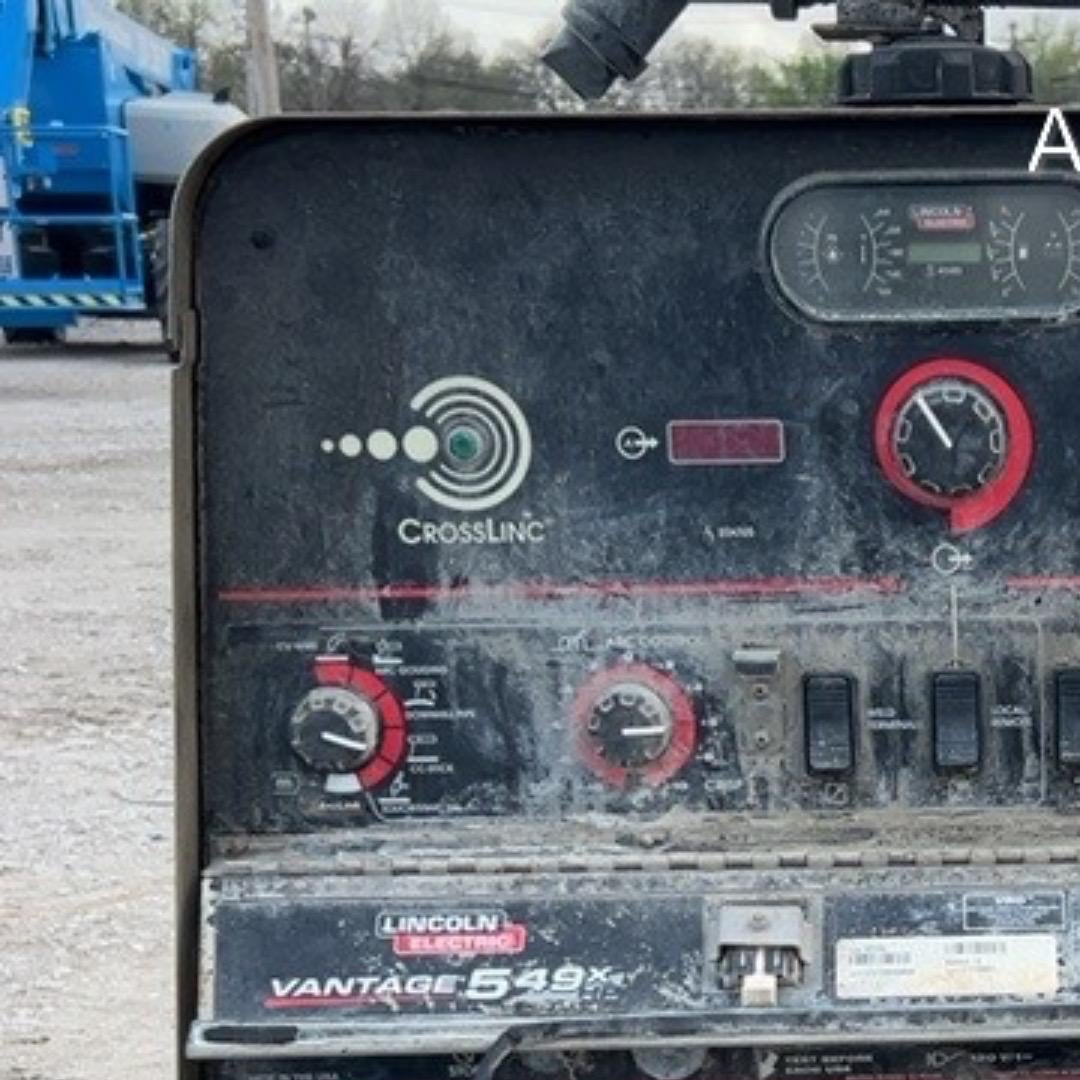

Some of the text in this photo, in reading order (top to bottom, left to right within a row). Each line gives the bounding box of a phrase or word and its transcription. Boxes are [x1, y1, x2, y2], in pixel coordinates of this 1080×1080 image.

[382, 913, 499, 932] LINCOLN
[408, 934, 512, 949] ELECTRIC
[271, 974, 465, 997] VANTAGE
